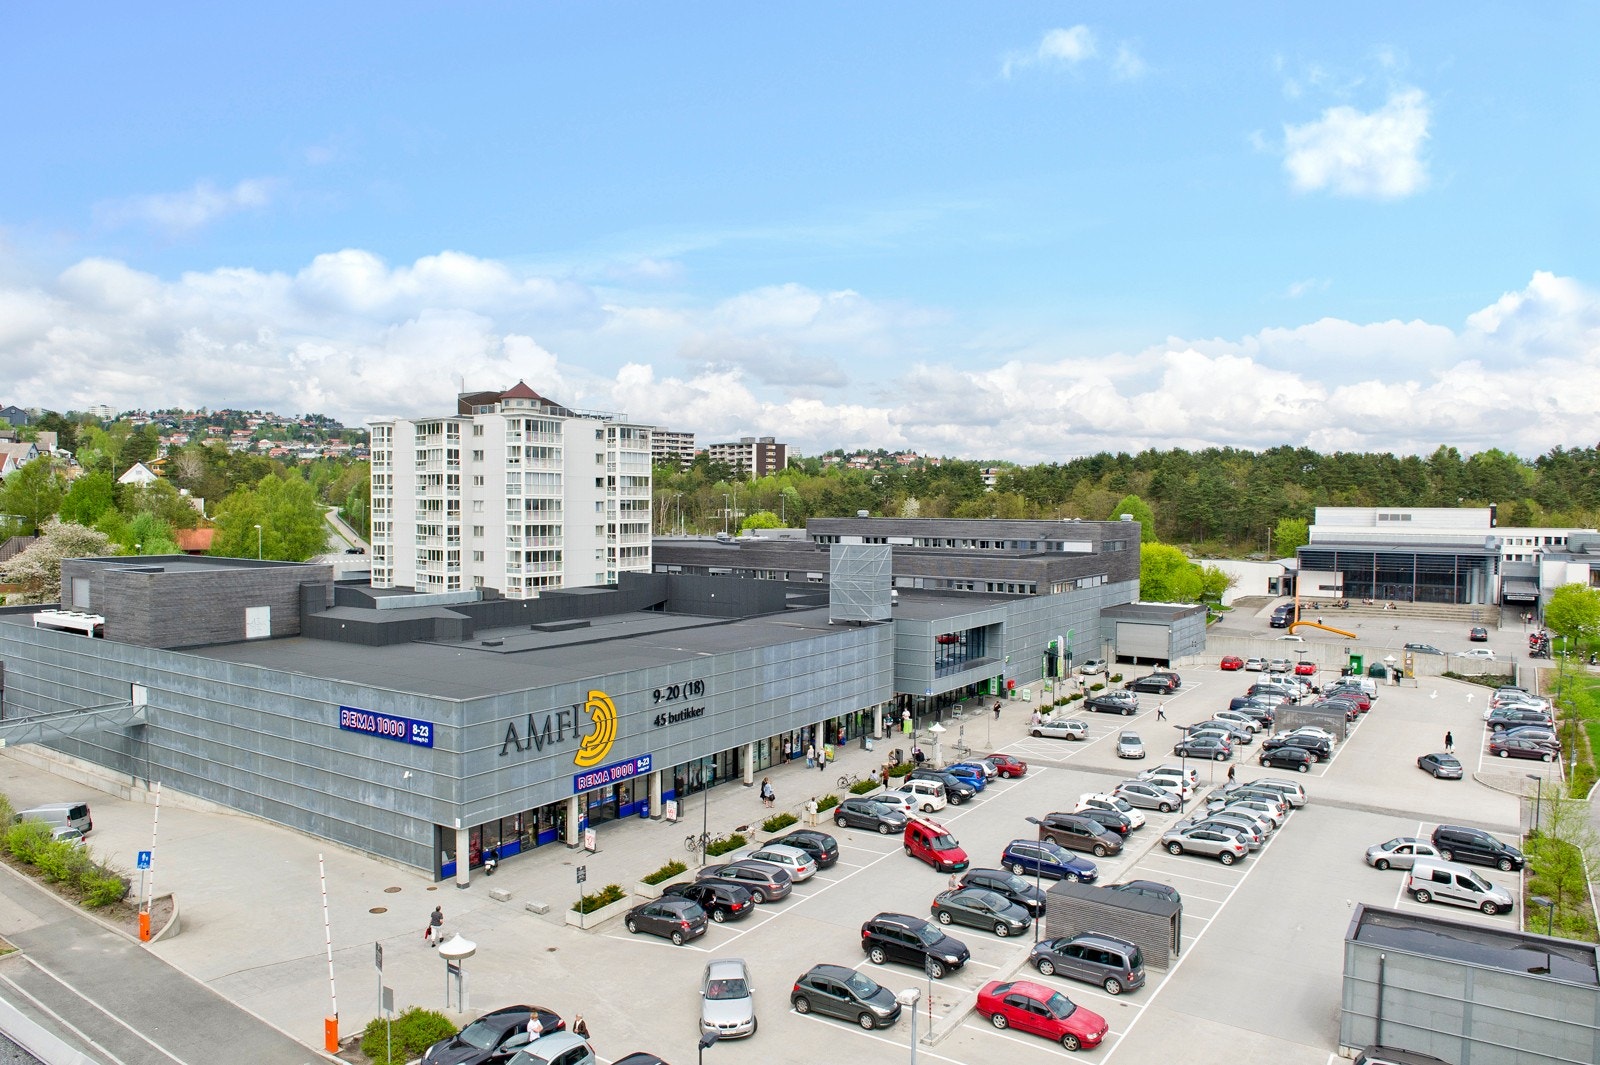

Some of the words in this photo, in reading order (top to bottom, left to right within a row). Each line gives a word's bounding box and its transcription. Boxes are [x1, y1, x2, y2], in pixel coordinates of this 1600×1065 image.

[653, 685, 680, 704] 9-20
[683, 679, 705, 700] (18)
[341, 710, 376, 732] REMA
[377, 717, 406, 738] 1000
[499, 703, 581, 756] AMFI
[653, 713, 667, 727] 45
[668, 706, 705, 724] butikker
[412, 724, 429, 737] 8-23
[578, 769, 609, 790] REMA
[610, 762, 634, 780] 1000
